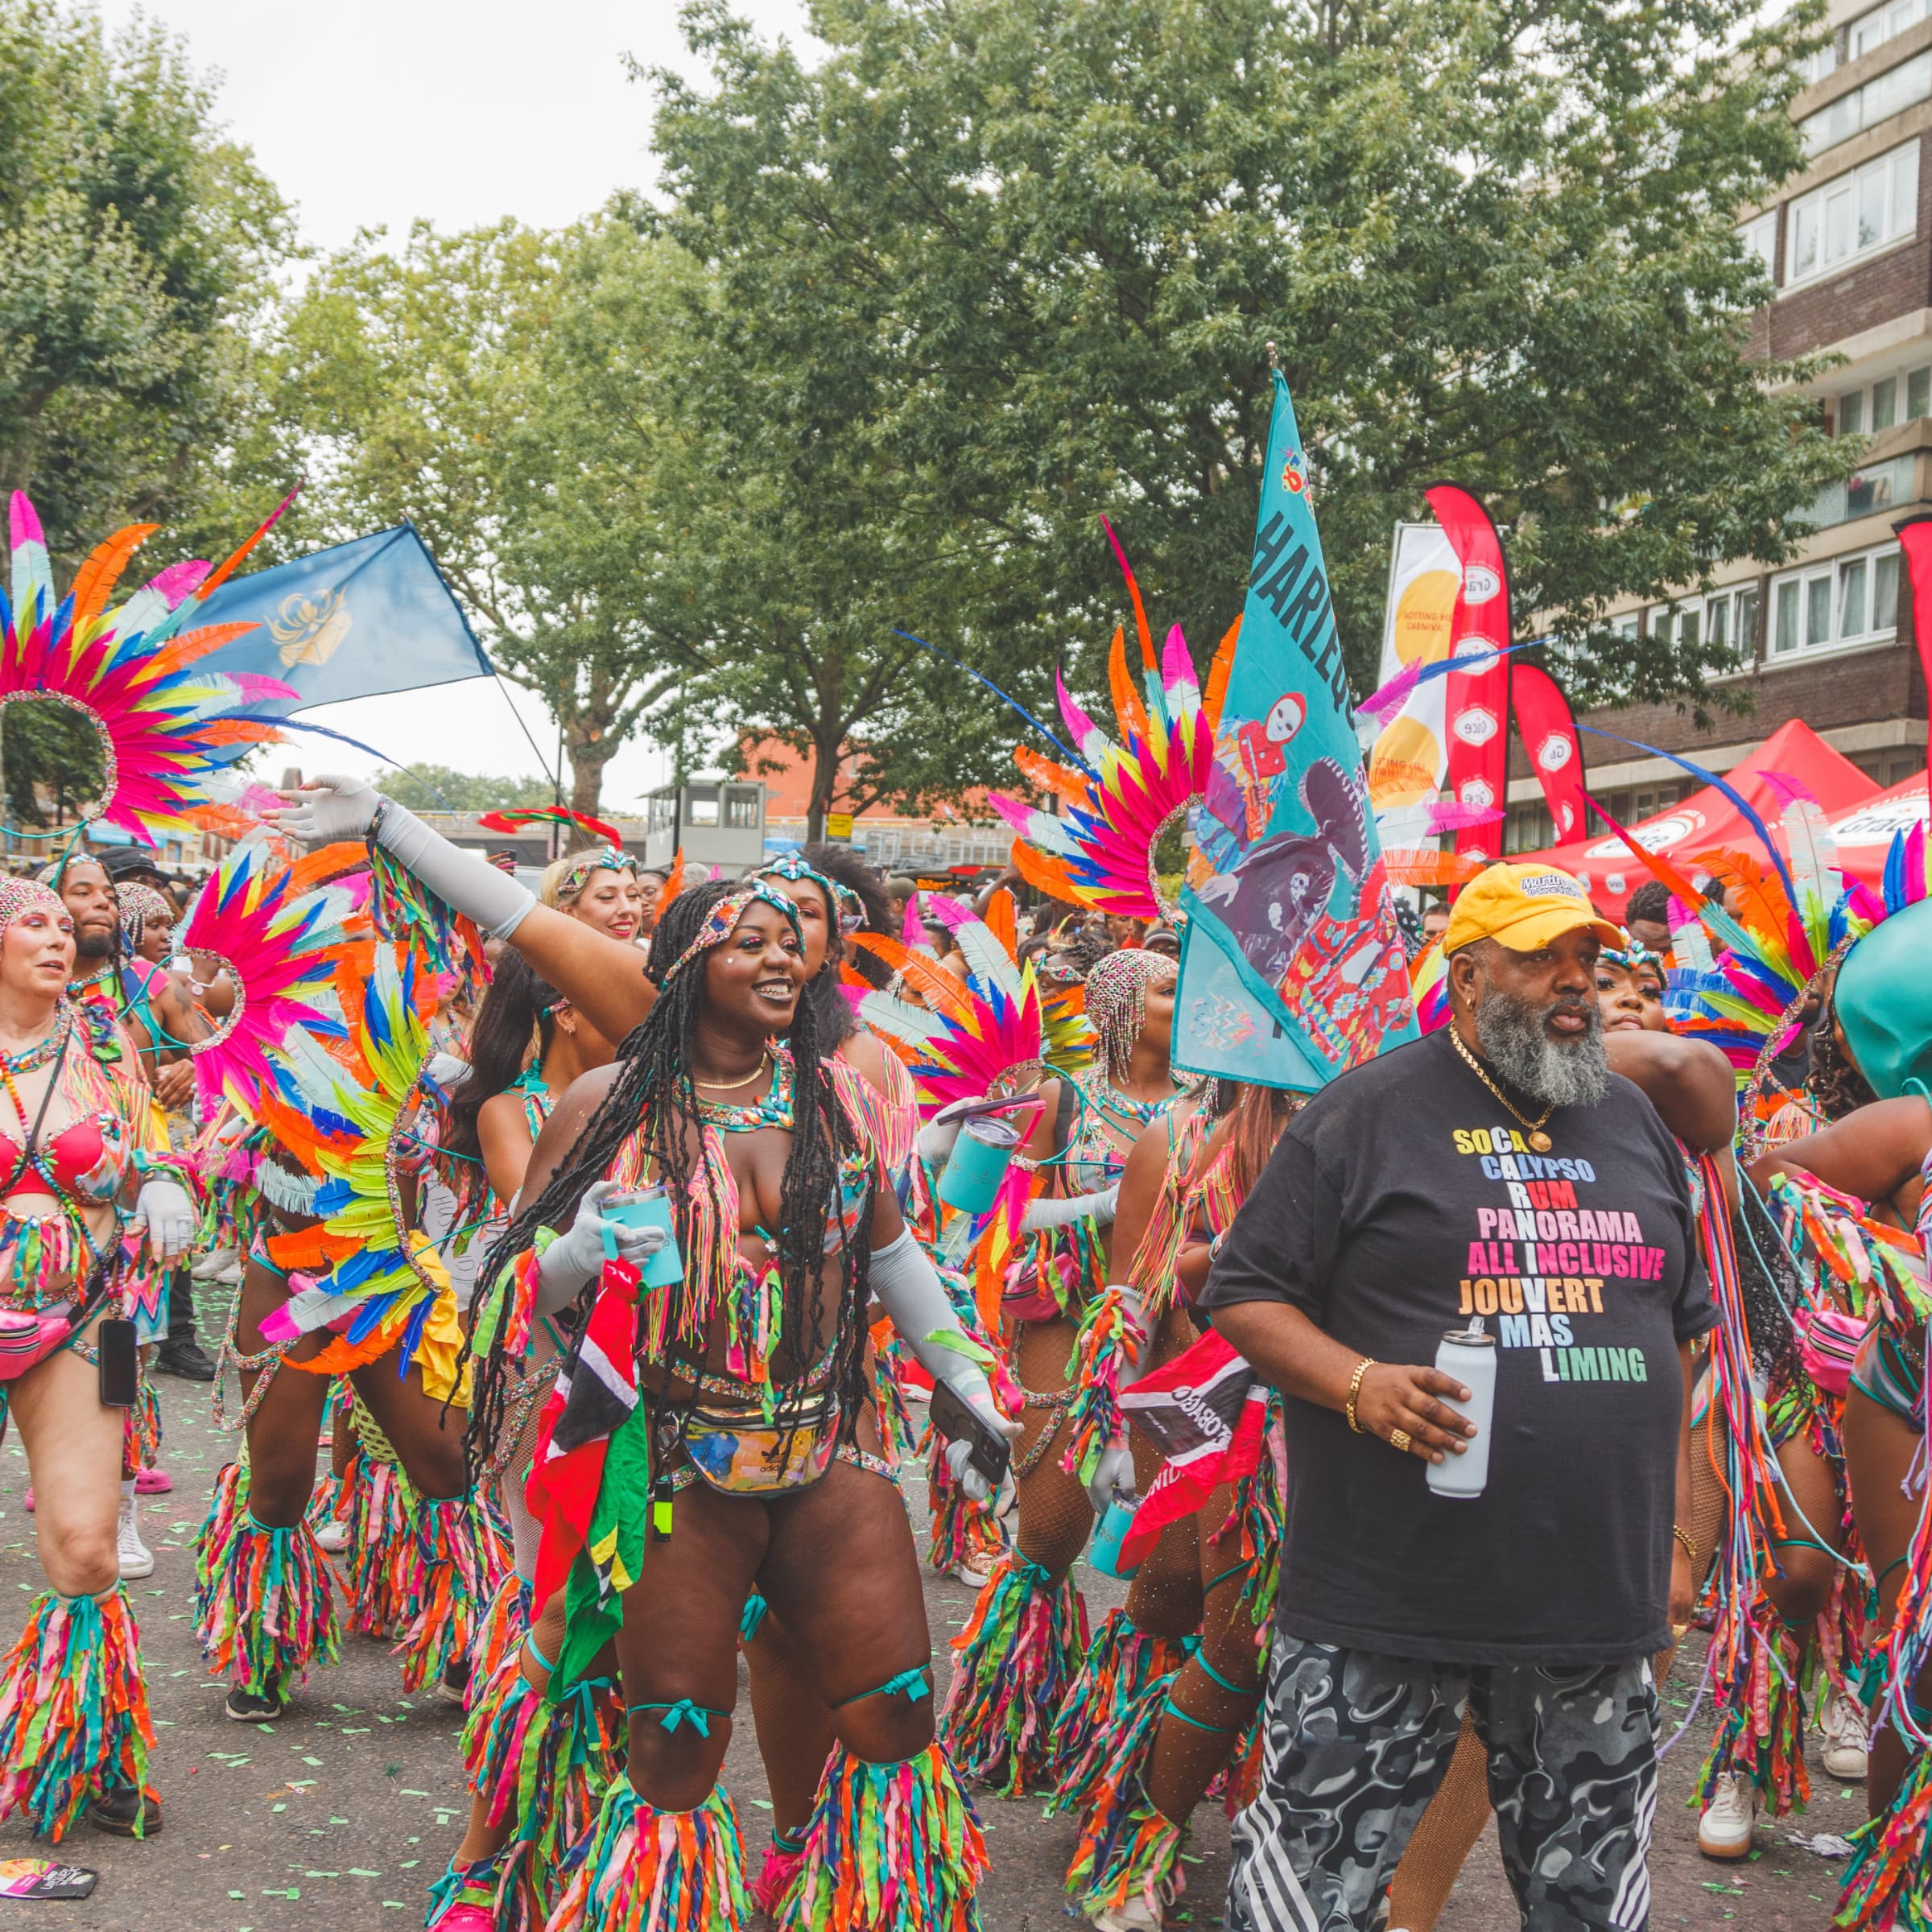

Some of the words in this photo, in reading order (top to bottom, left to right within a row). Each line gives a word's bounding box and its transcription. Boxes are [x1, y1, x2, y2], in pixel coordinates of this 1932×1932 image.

[1403, 611, 1437, 621] NOTTING
[1452, 1126, 1530, 1155] SOCA
[1480, 1154, 1596, 1183] CALYPSO
[1506, 1181, 1579, 1209] RUM
[1477, 1208, 1645, 1244] PANORAMA
[1467, 1241, 1521, 1276] ALL
[1525, 1242, 1666, 1282] INCLUSIVE
[1459, 1277, 1604, 1315] JOUVERT
[1499, 1313, 1575, 1348] MAS
[1540, 1347, 1649, 1383] LIMING
